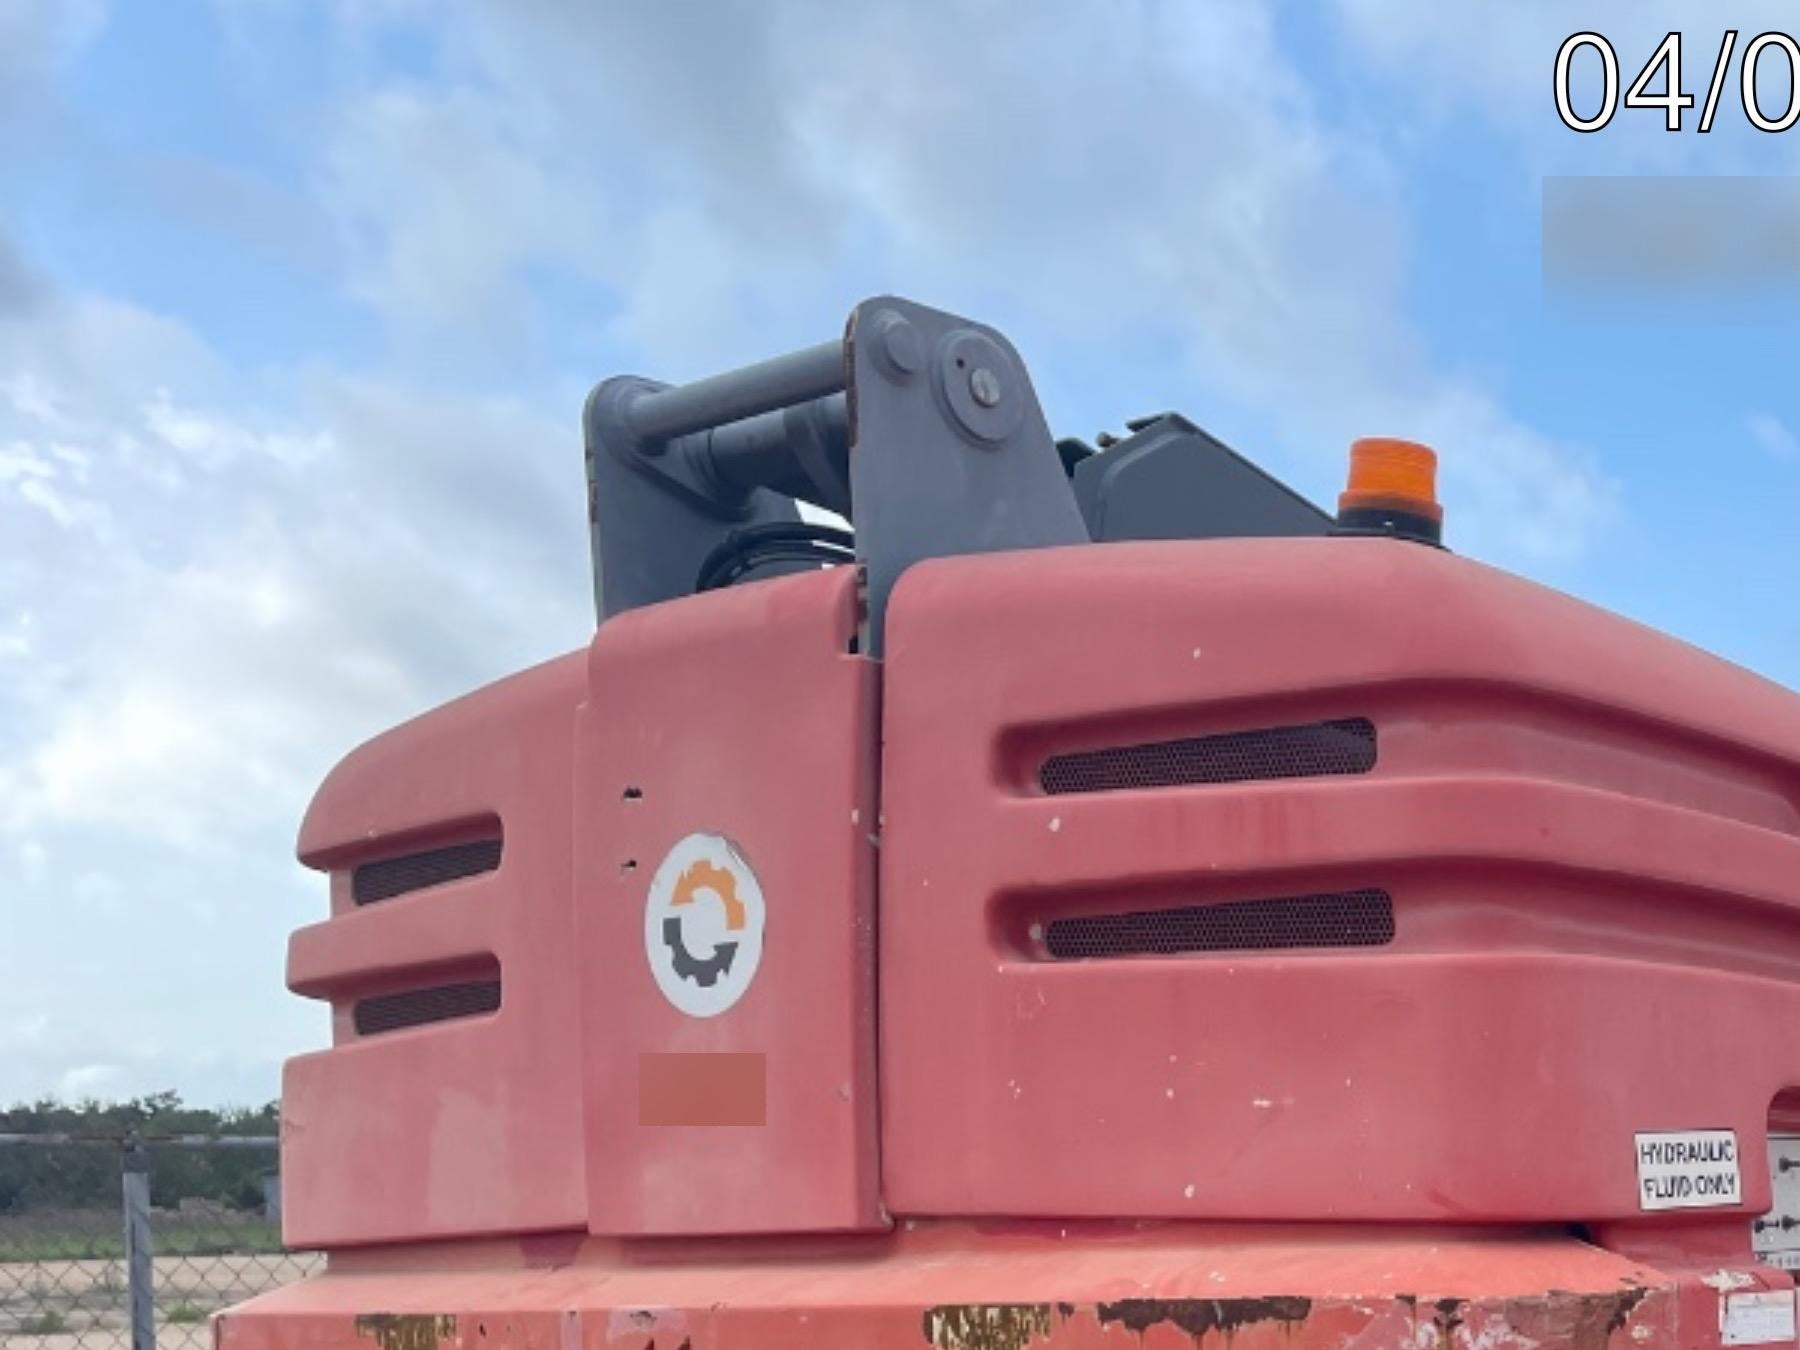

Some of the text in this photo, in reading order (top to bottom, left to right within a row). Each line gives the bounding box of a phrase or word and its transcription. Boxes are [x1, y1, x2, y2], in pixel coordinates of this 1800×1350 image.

[1641, 1140, 1733, 1165] HYDRAULIC
[1644, 1173, 1734, 1199] FLUID ONLY
